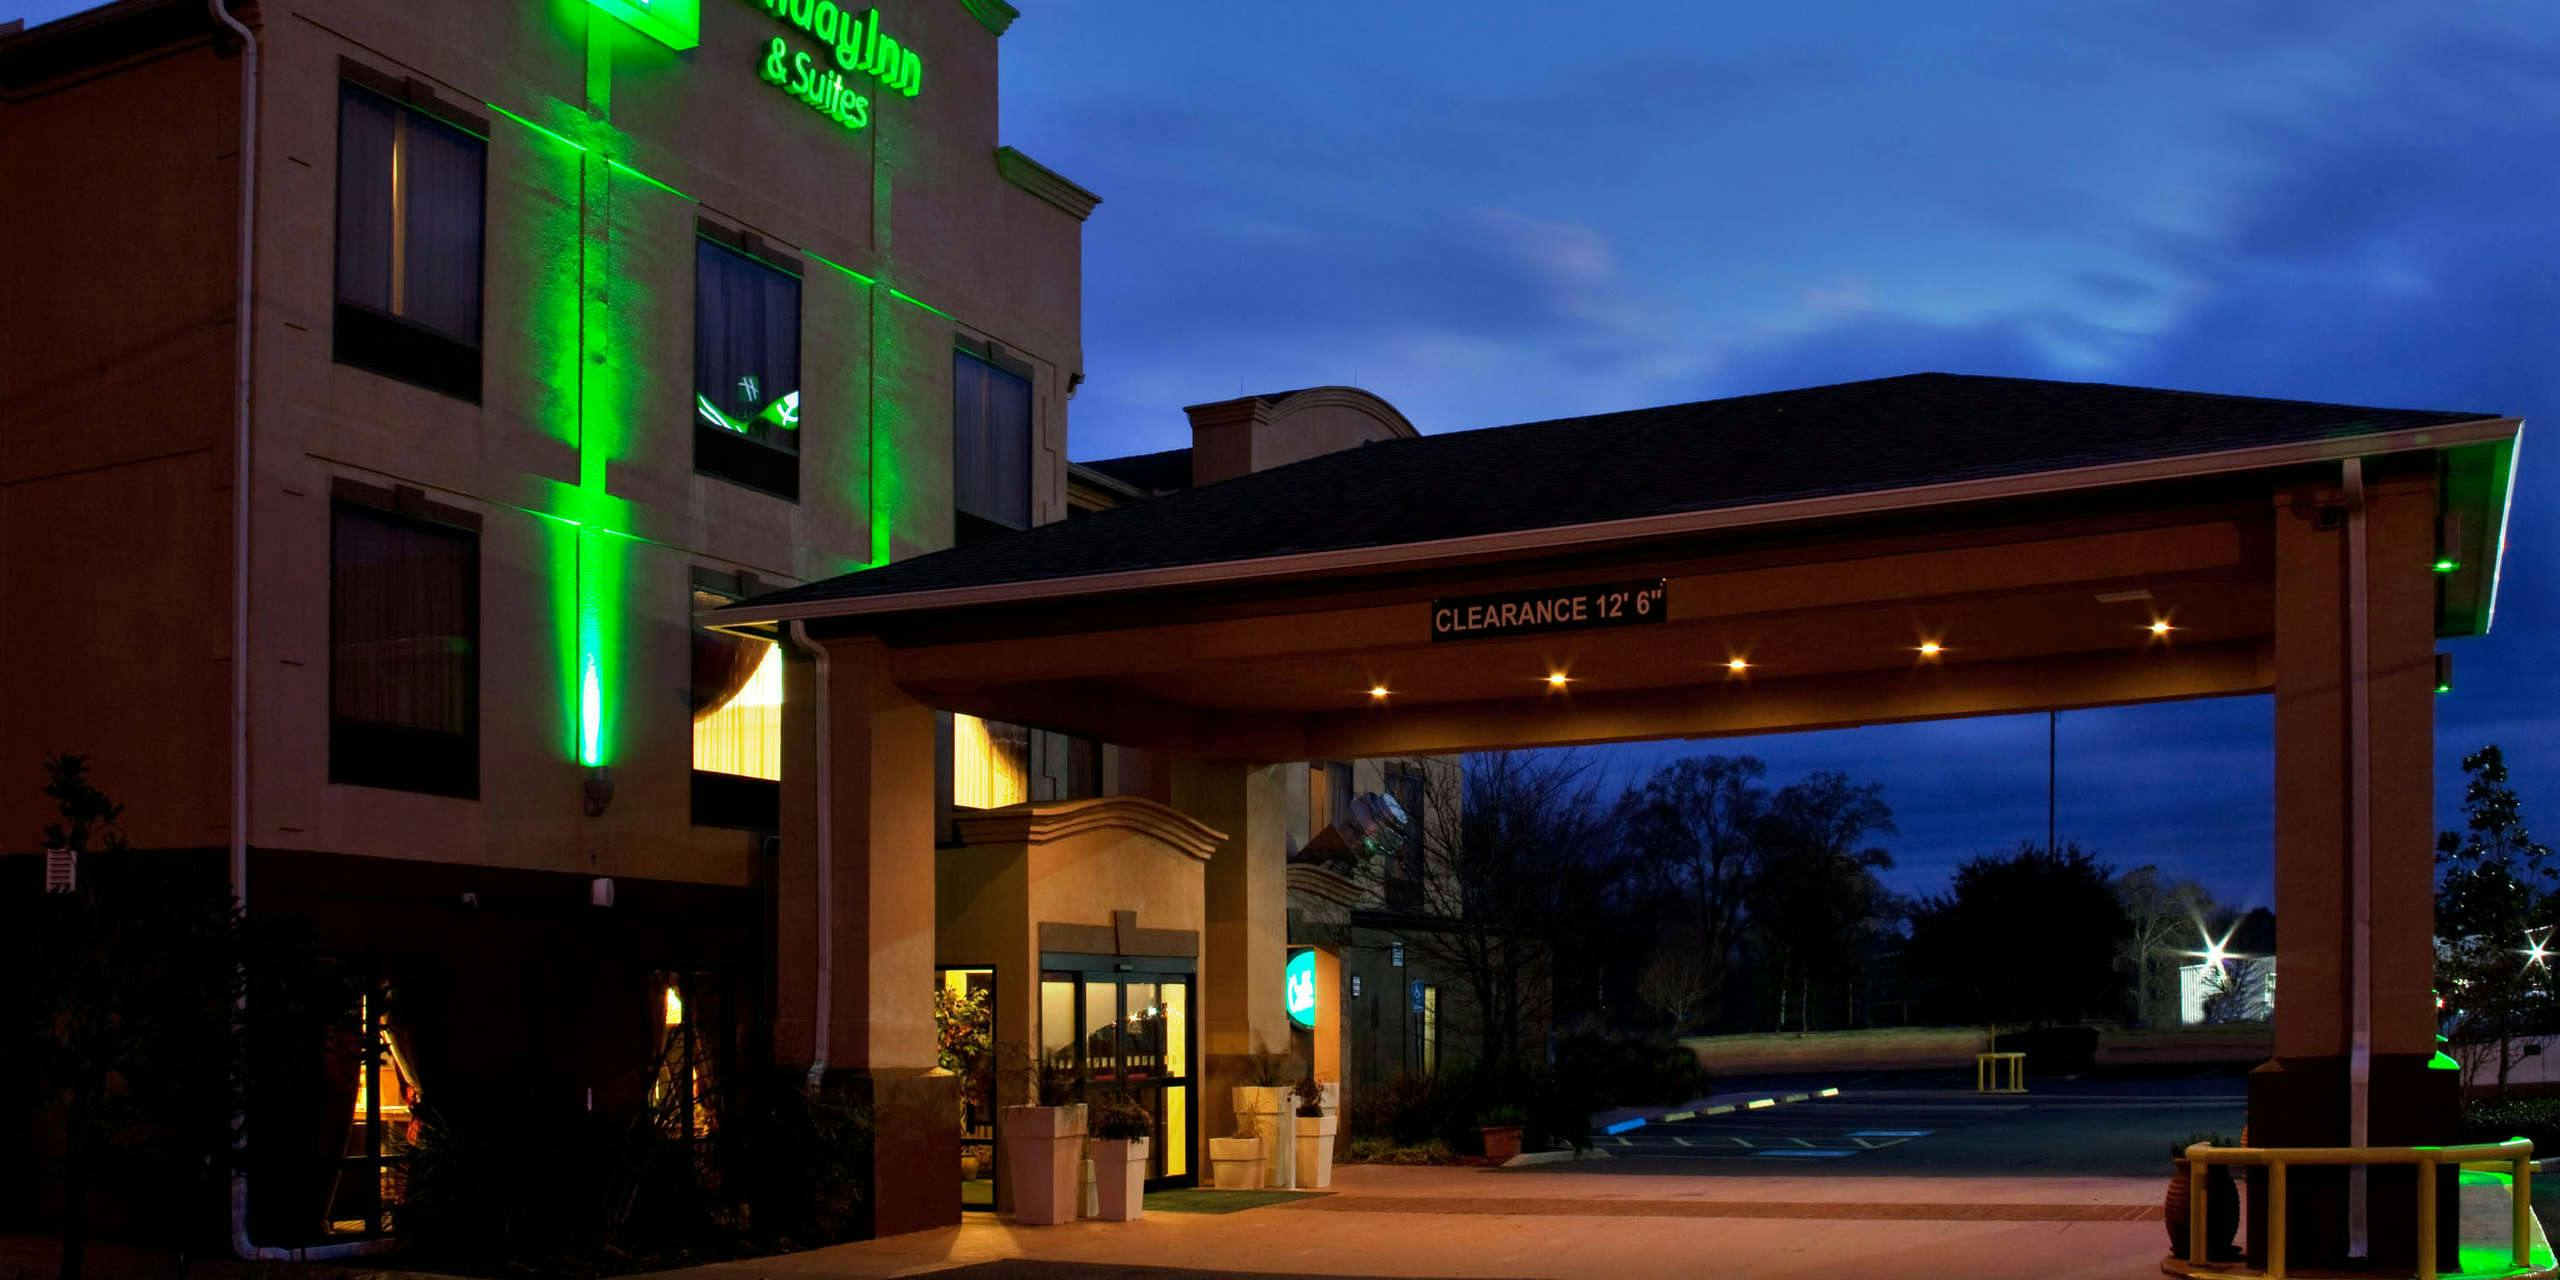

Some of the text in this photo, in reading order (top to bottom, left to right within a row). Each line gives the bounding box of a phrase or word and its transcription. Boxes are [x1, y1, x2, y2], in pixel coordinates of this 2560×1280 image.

[764, 37, 870, 128] & Suites
[1435, 589, 1662, 632] CLEARANCE 12' 6"
